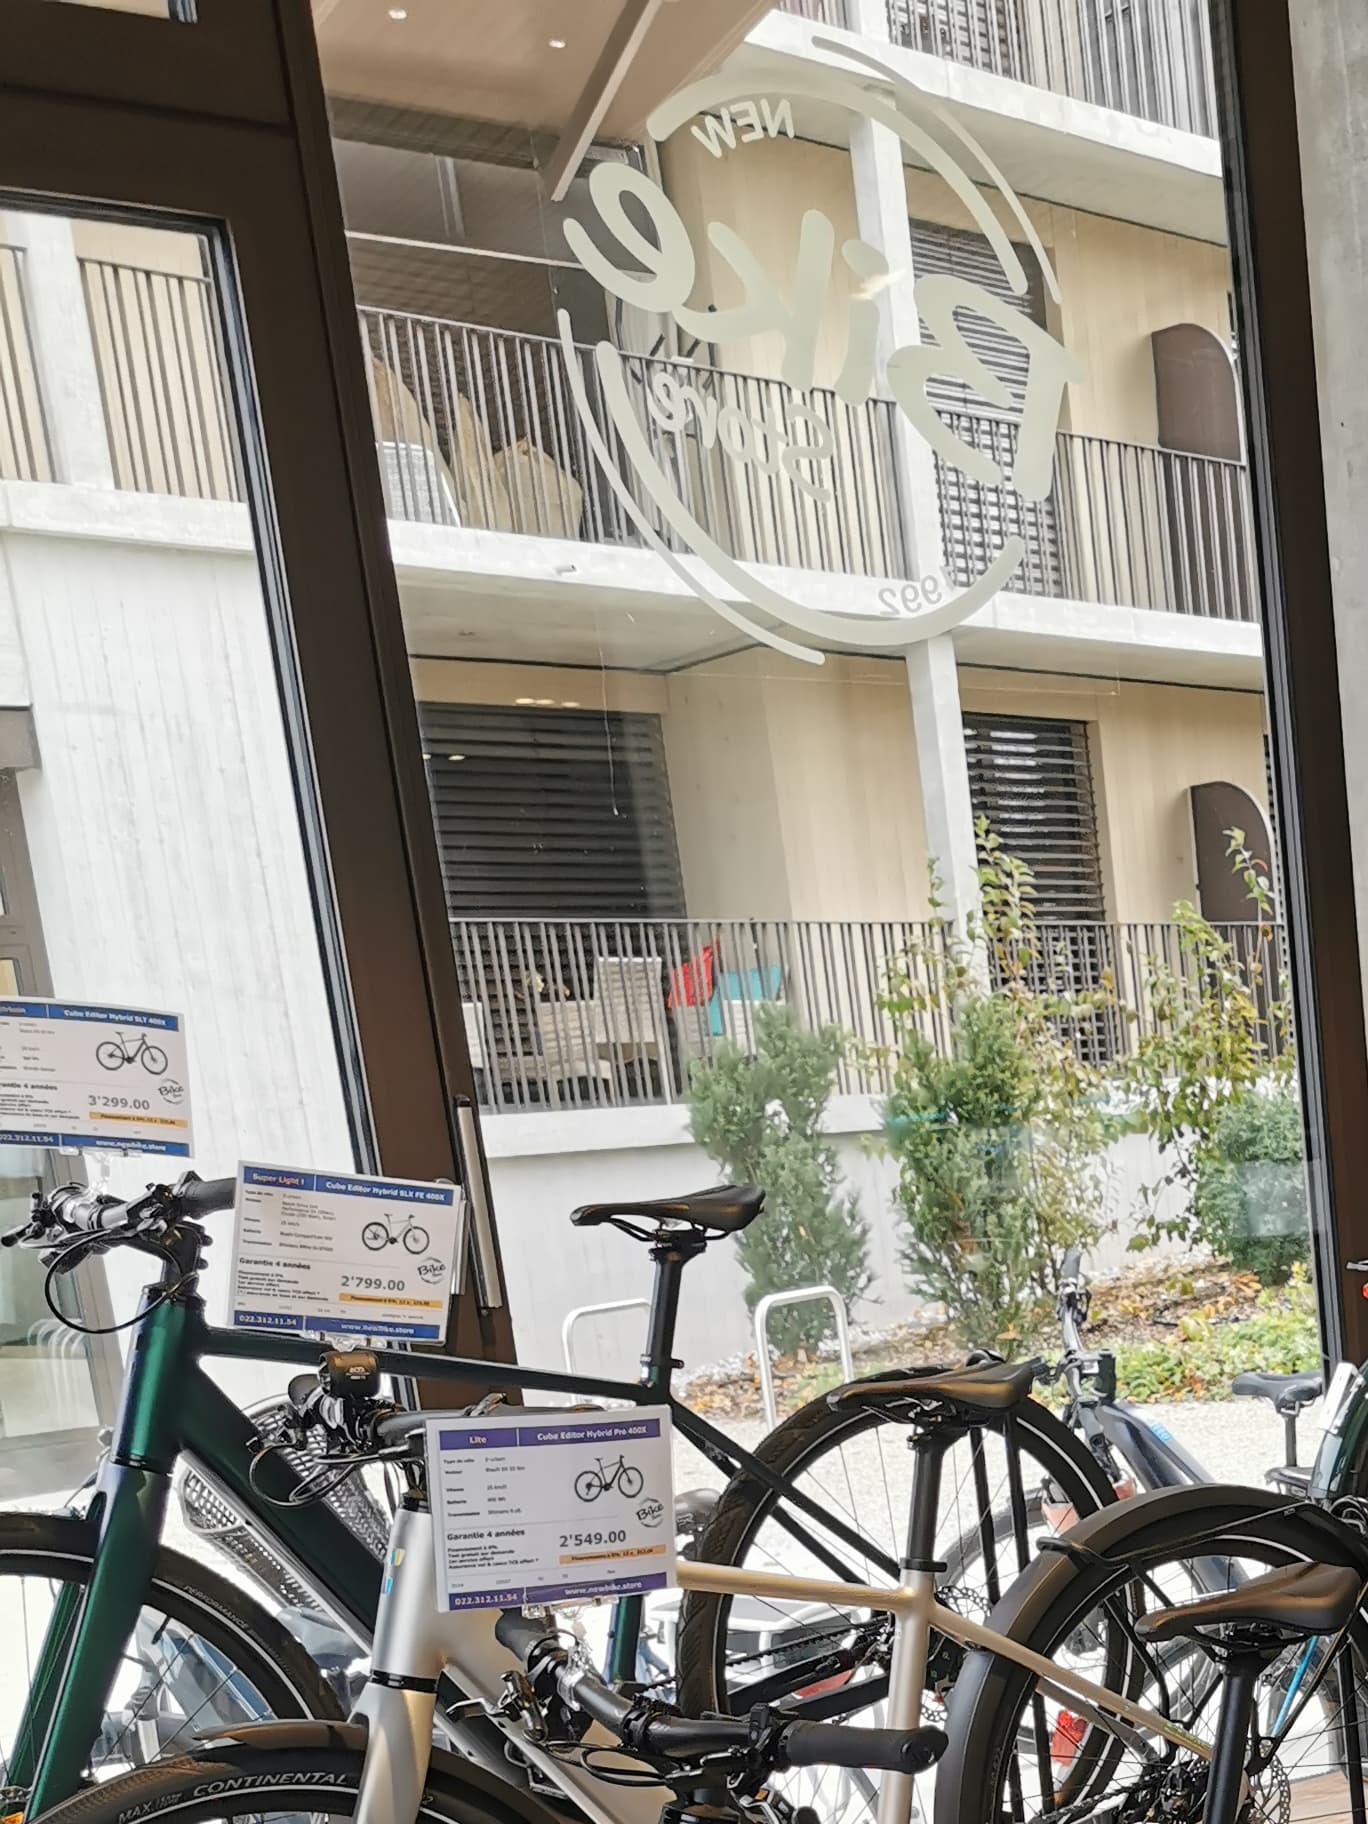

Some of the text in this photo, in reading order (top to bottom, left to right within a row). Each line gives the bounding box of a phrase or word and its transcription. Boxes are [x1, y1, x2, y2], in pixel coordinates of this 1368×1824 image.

[158, 1084, 184, 1096] Bike
[88, 1095, 150, 1110] 3'299.00
[326, 1181, 346, 1190] Cube
[347, 1184, 371, 1193] Editor
[372, 1186, 397, 1197] Hybrid
[239, 1257, 273, 1266] Garantie
[417, 1263, 446, 1276] Bike
[340, 1274, 405, 1291] 2'799.00
[468, 1435, 487, 1444] Lite
[537, 1425, 647, 1440] Cube Editor Hybrid Pro 400X
[636, 1502, 664, 1521] Bike
[447, 1530, 484, 1541] Garantie
[494, 1527, 524, 1537] années
[559, 1529, 626, 1547] 2'549.00
[454, 1592, 517, 1606] 022.312.11.54
[118, 1772, 348, 1824] MAX CONTINENTAL
